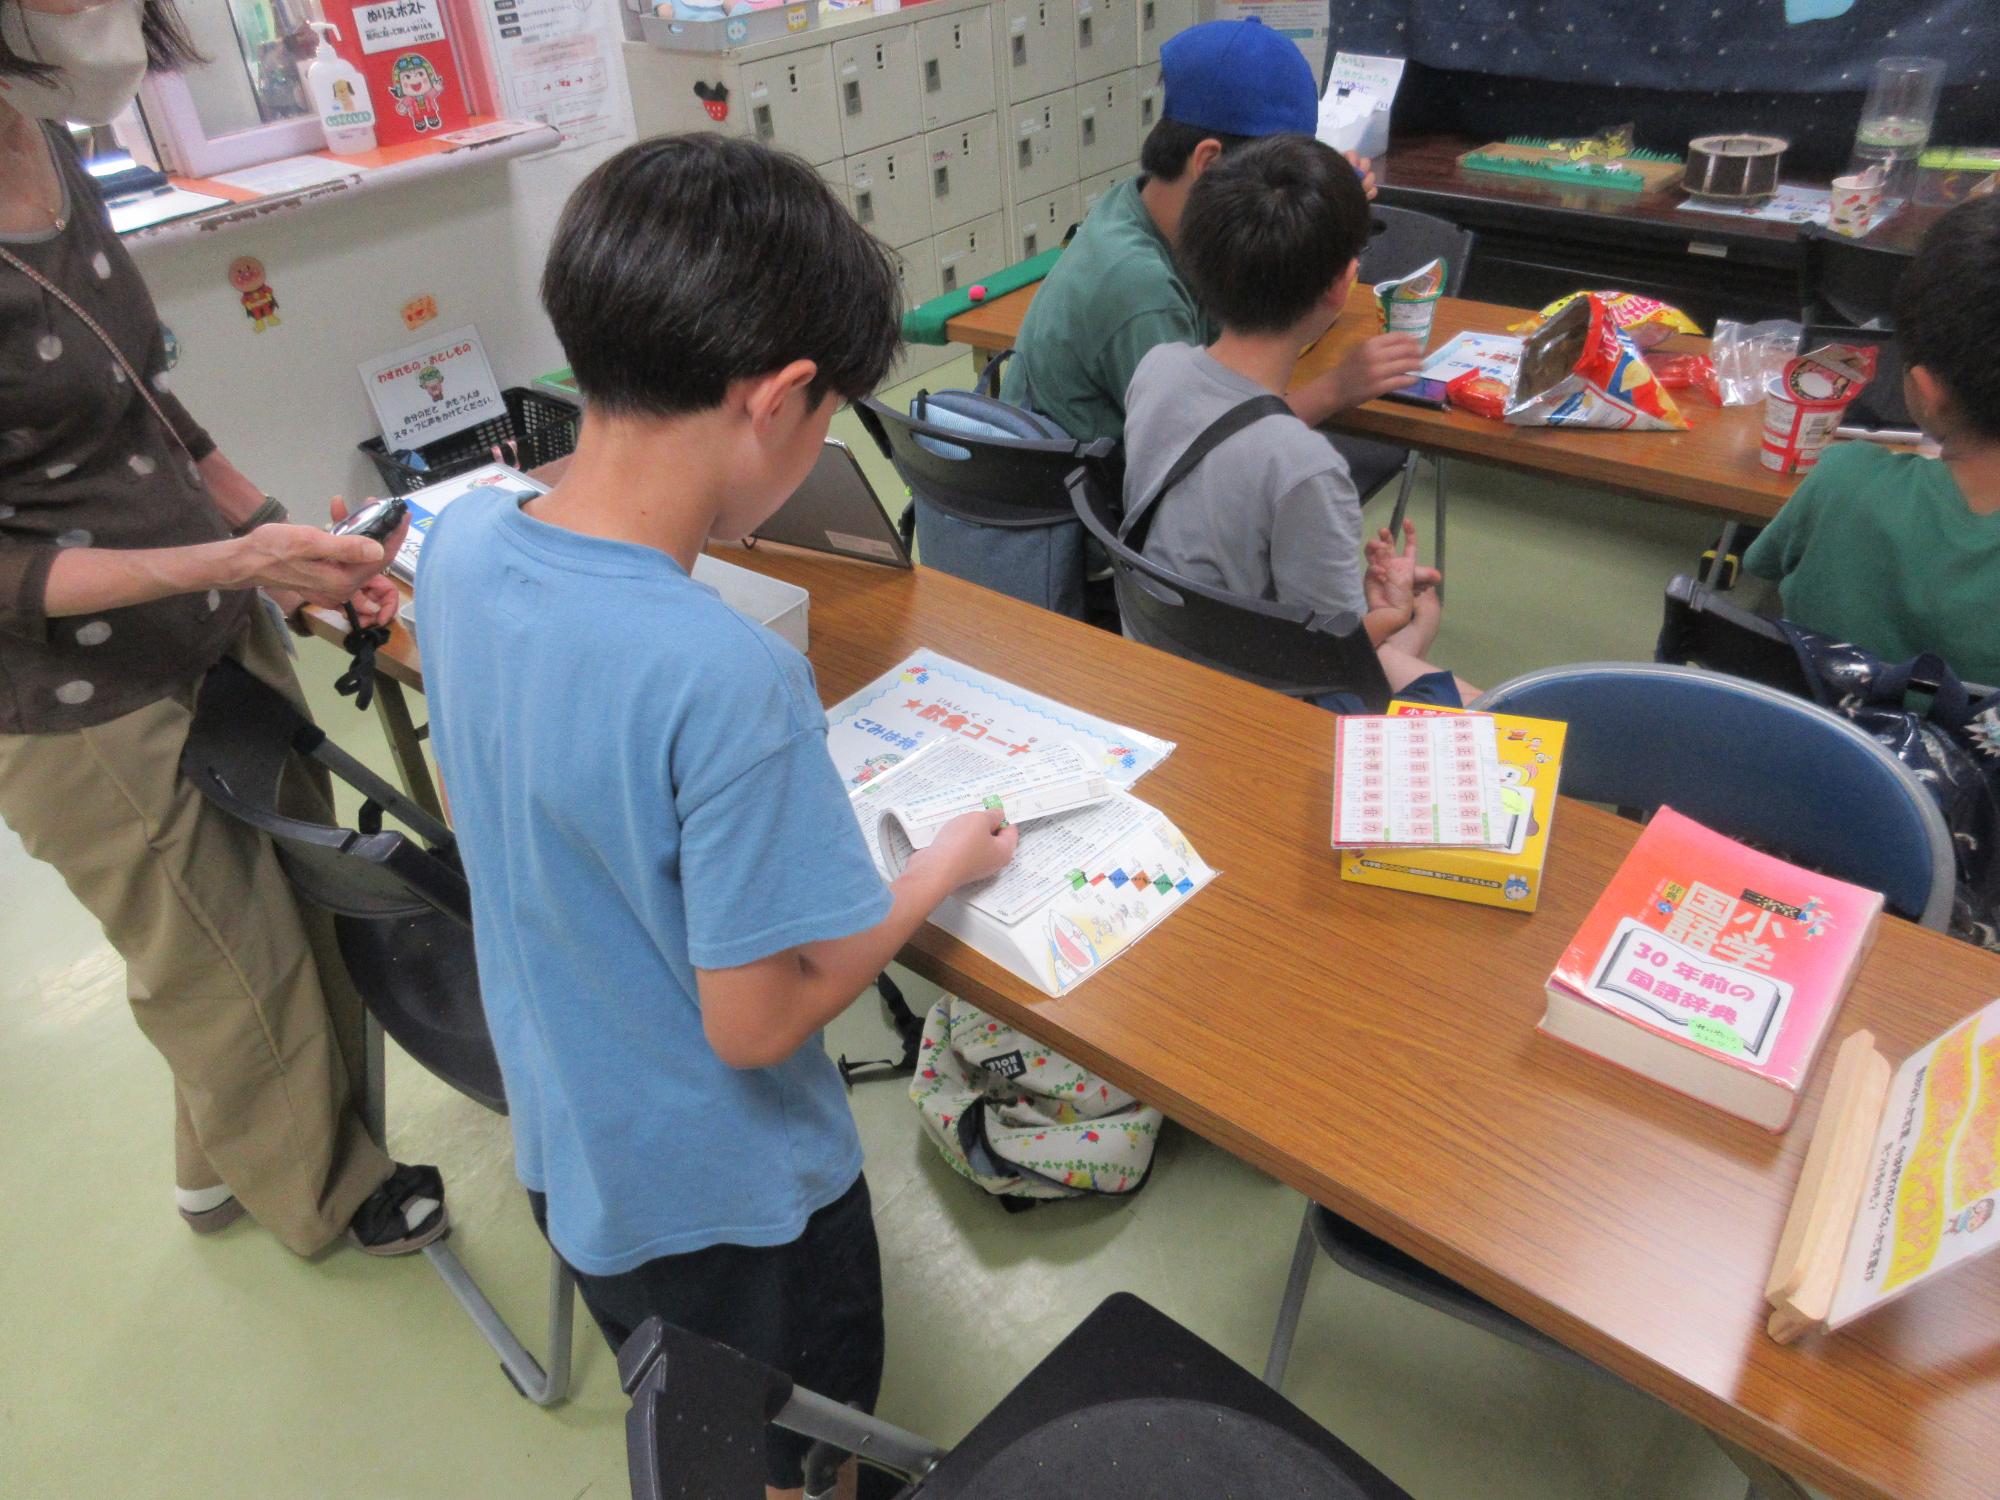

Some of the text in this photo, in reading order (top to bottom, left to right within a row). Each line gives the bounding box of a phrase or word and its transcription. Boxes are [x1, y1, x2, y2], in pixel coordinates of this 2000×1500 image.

[367, 2, 425, 23] ぬりえポスト
[445, 390, 480, 408] おもう人は
[854, 718, 919, 751] ごみは持
[1626, 968, 1738, 1025] 国語辞典
